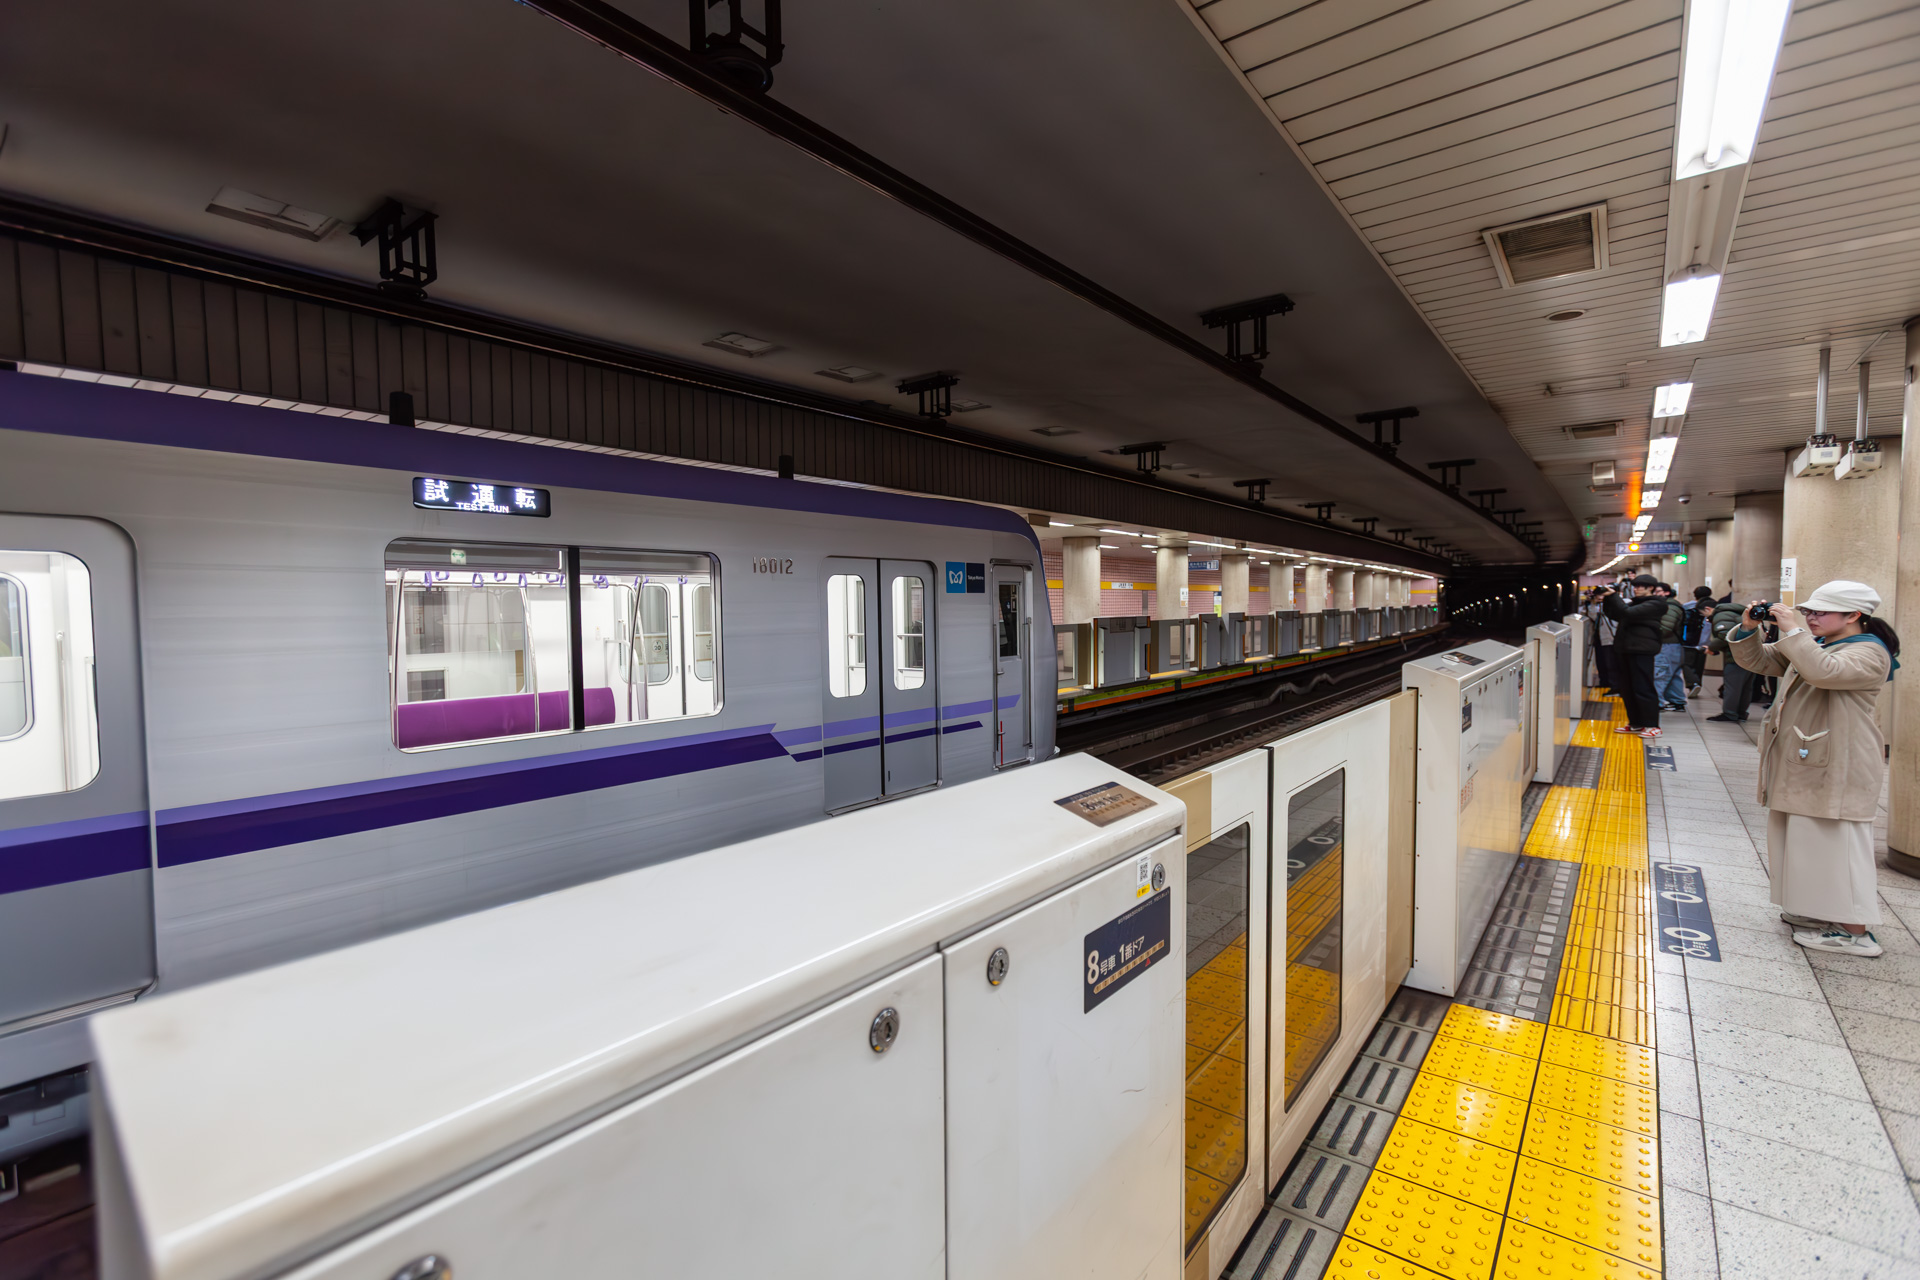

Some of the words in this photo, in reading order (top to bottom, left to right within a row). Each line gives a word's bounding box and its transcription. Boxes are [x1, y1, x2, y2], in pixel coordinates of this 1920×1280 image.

[423, 478, 537, 509] 試運転
[456, 501, 487, 512] TEST
[488, 503, 510, 514] RUN
[753, 557, 793, 575] 18012
[1087, 949, 1116, 985] 8号車
[1119, 935, 1144, 964] 1番ドア
